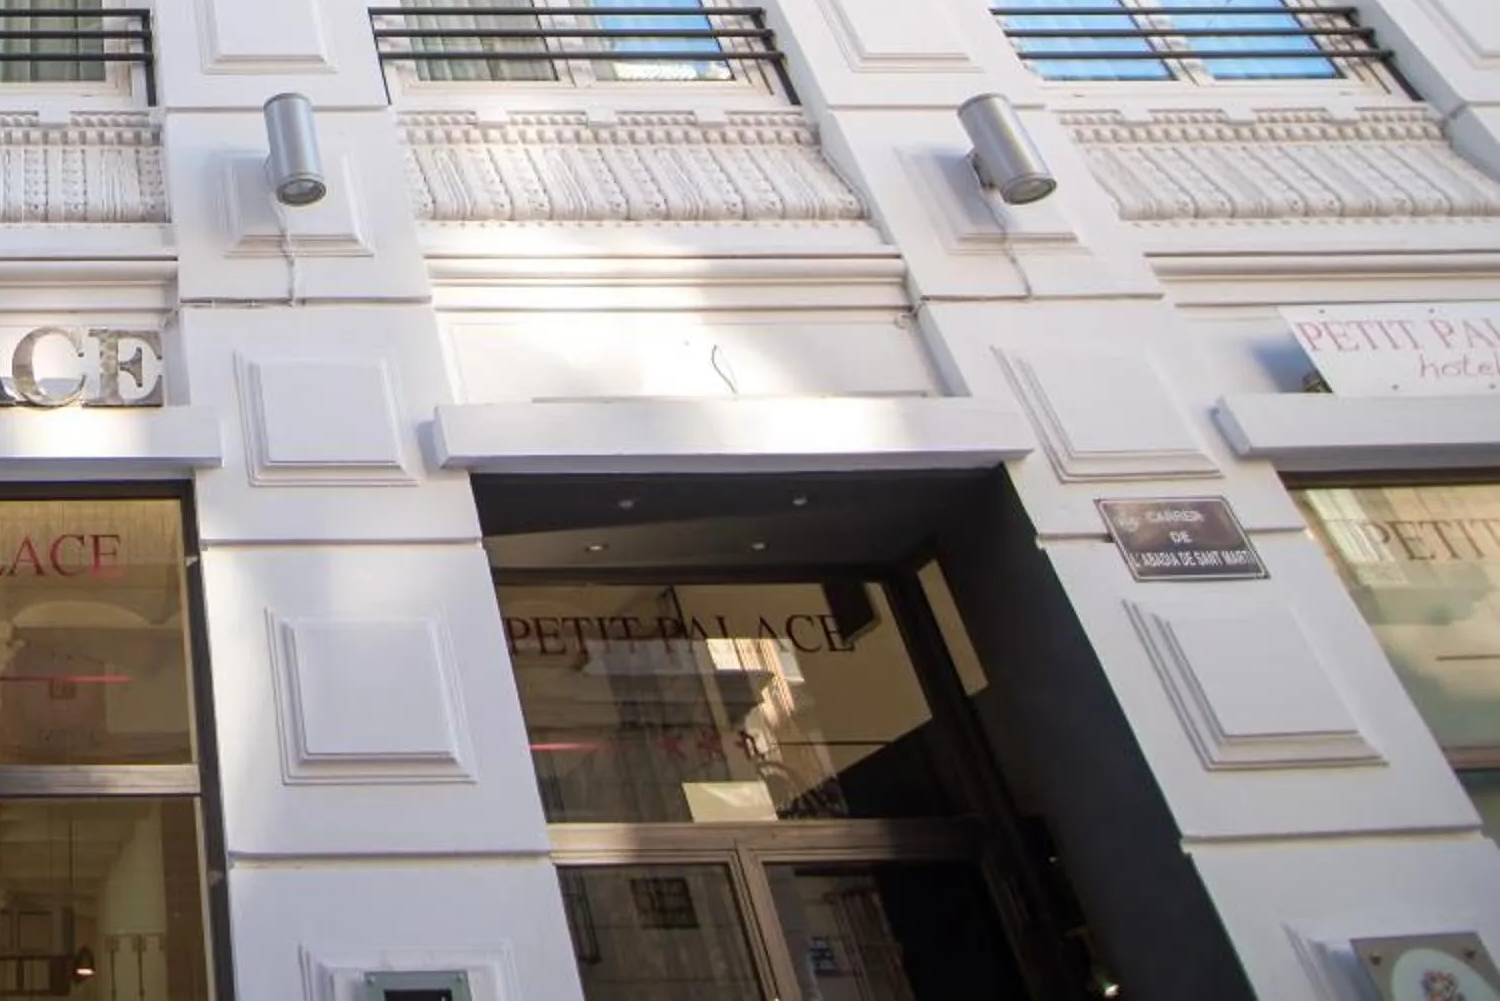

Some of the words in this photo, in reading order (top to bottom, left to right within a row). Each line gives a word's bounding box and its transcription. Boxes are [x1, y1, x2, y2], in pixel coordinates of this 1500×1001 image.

[1295, 319, 1421, 351] PETIT
[1419, 351, 1500, 378] hotel
[1145, 509, 1204, 522] CARRER
[1169, 530, 1193, 544] DE
[502, 615, 640, 656] PETIT
